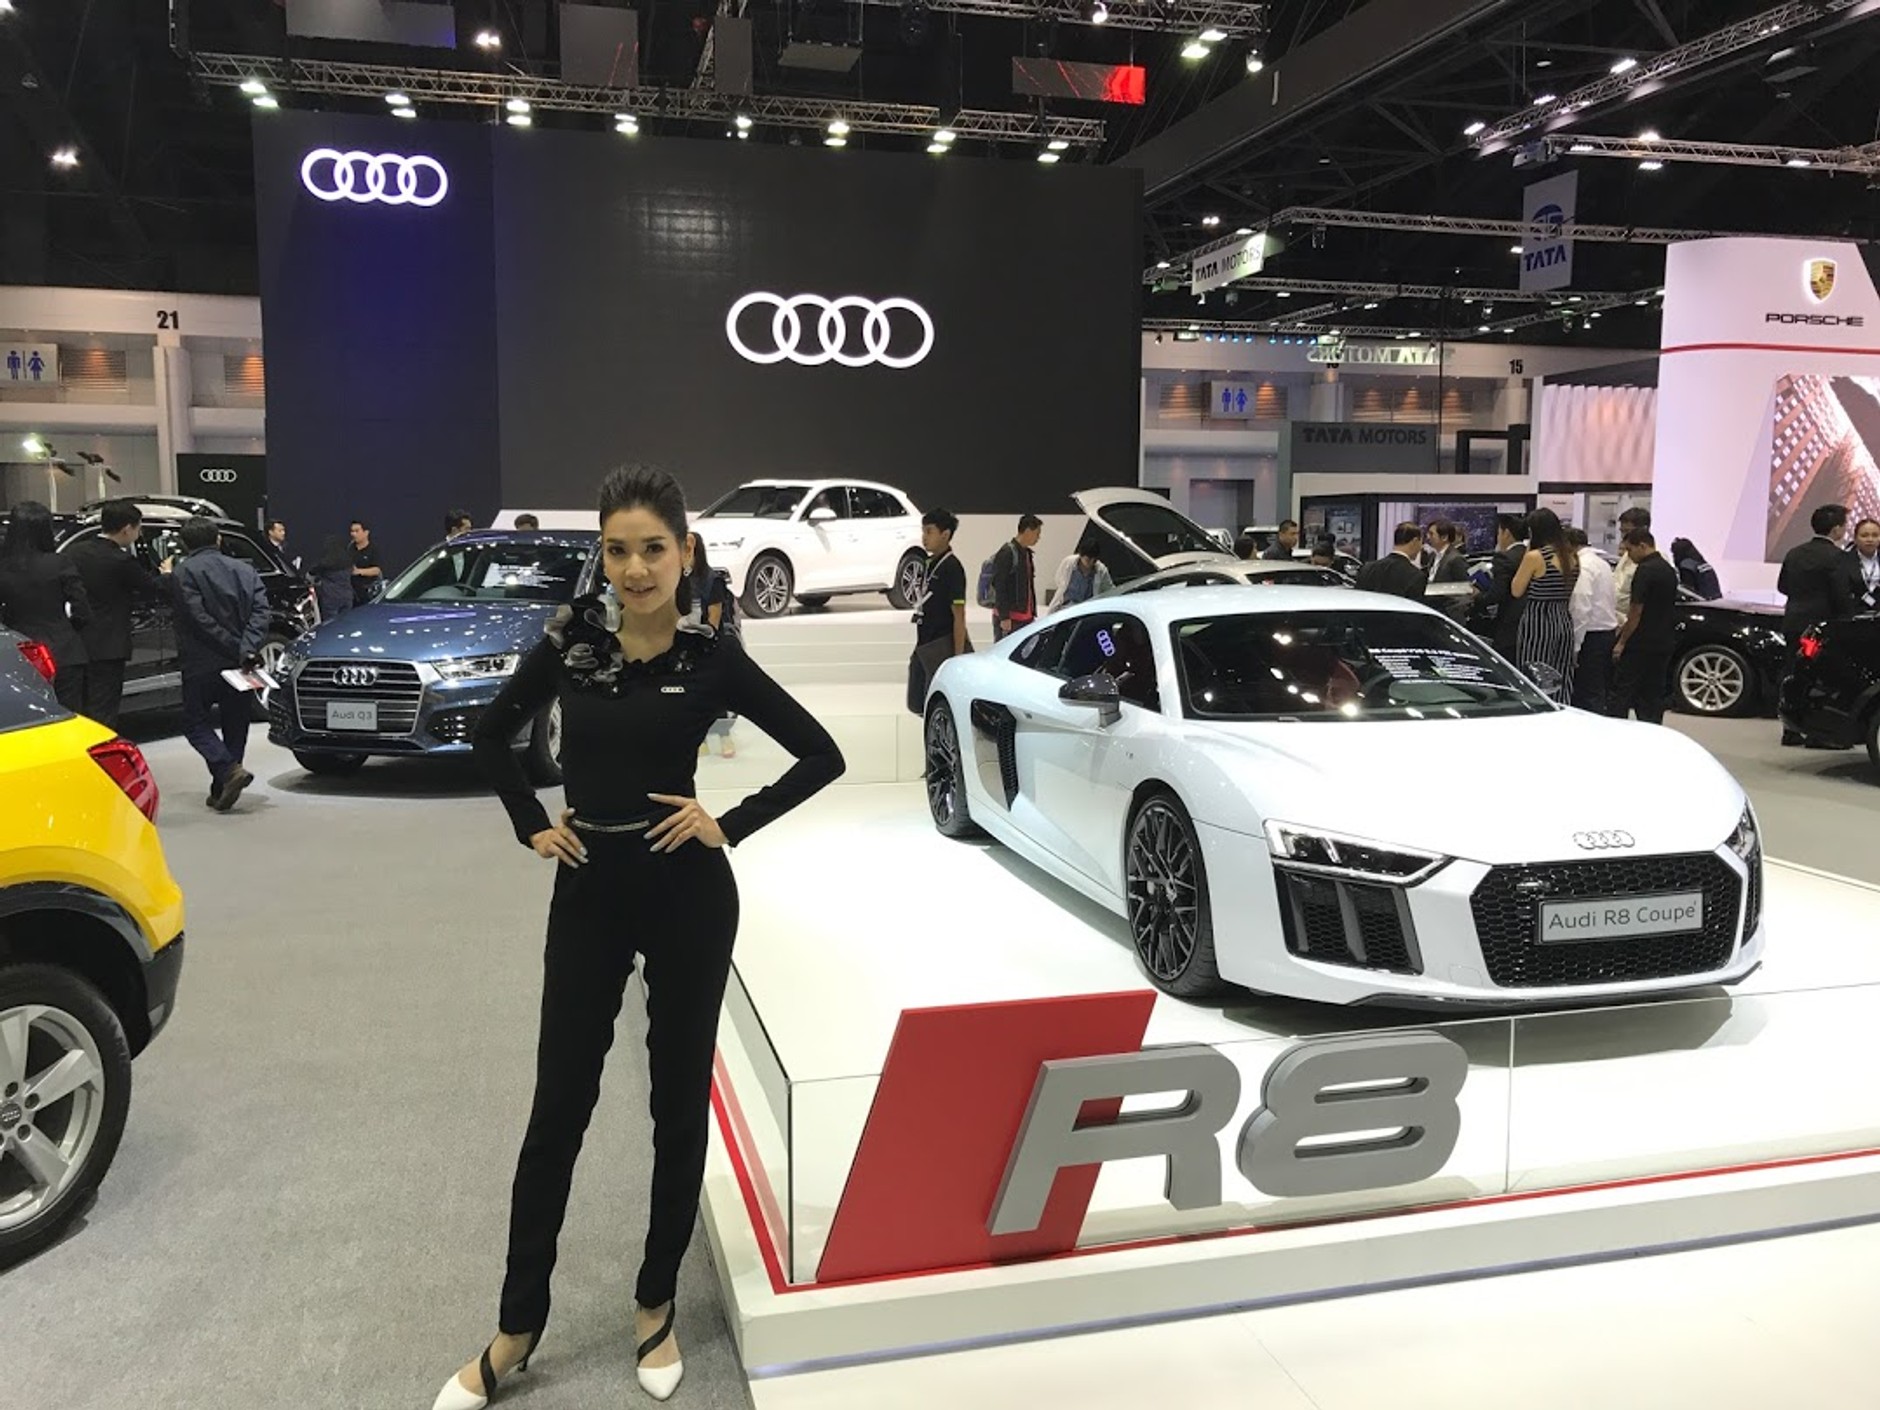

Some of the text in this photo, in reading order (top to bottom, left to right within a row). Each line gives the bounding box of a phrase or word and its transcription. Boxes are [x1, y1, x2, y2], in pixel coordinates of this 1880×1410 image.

[1524, 244, 1566, 271] TATA
[1196, 261, 1218, 282] TATA
[157, 310, 179, 329] 21
[1765, 313, 1864, 327] PORSCHE
[1509, 359, 1523, 374] 15
[1302, 428, 1427, 445] TATA MOTORS
[332, 710, 372, 721] Audi Q3
[1549, 911, 1597, 930] Audi
[1604, 908, 1631, 926] R8
[985, 1030, 1468, 1236] R8
